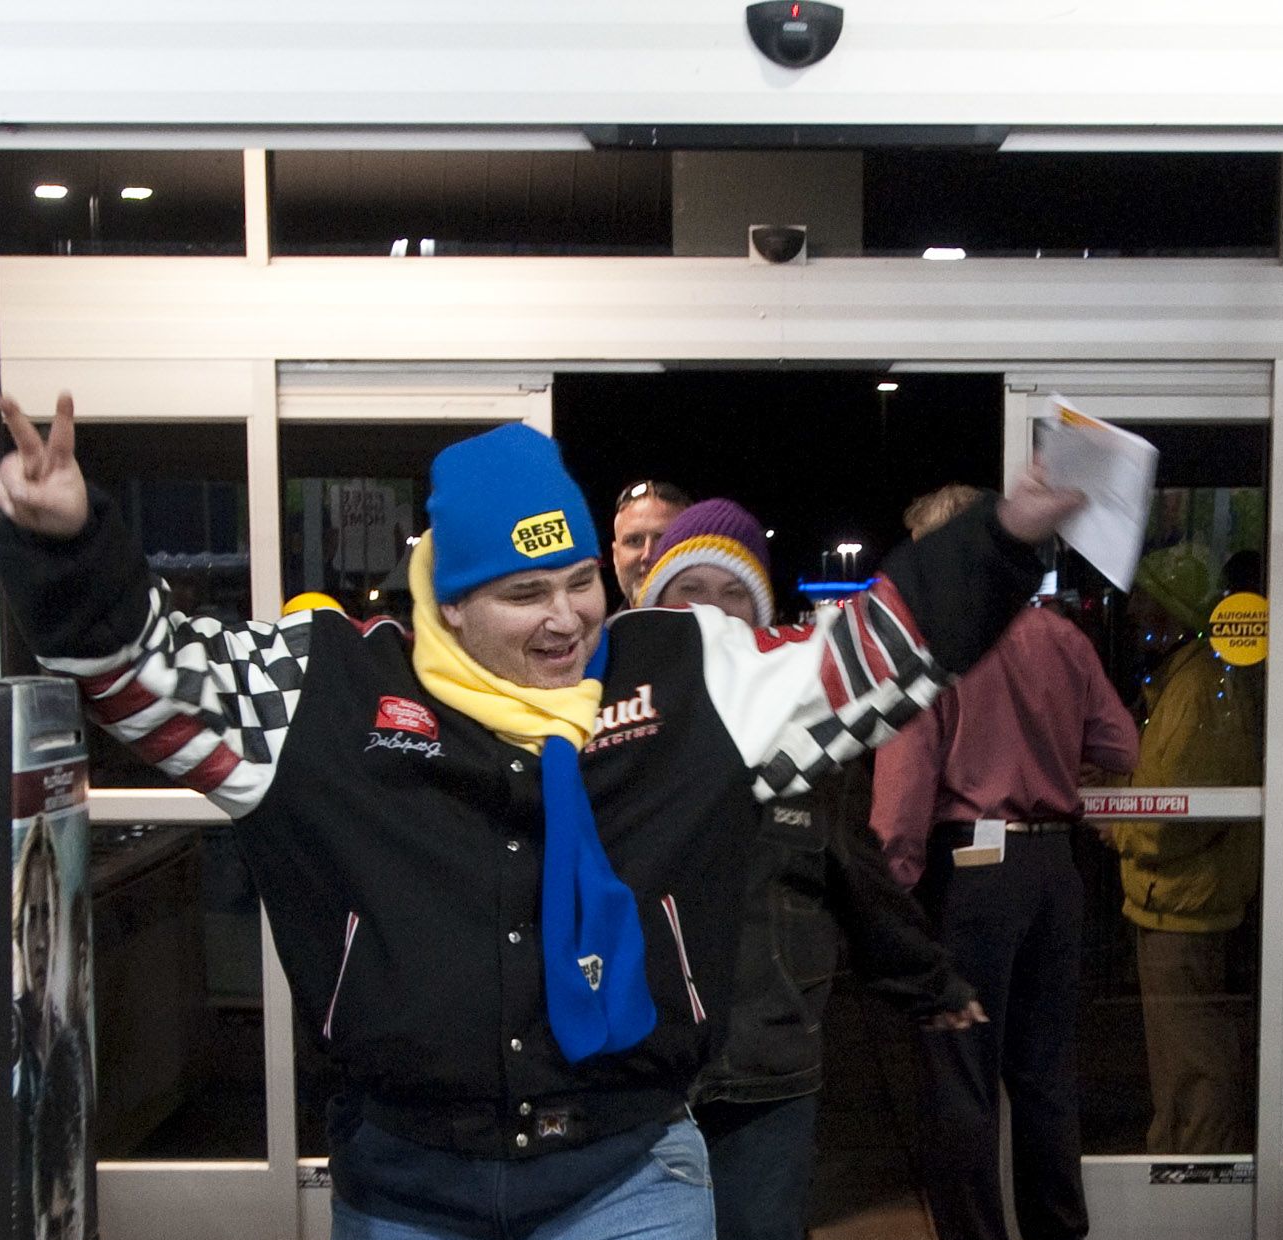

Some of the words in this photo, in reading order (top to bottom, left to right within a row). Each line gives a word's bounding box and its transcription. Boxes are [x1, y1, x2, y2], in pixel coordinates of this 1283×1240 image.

[517, 518, 566, 541] BEST
[523, 531, 565, 552] BUY
[1229, 639, 1257, 647] DOOR
[1108, 797, 1138, 811] PUSH
[1140, 797, 1154, 811] TO
[1156, 797, 1186, 811] OPEN
